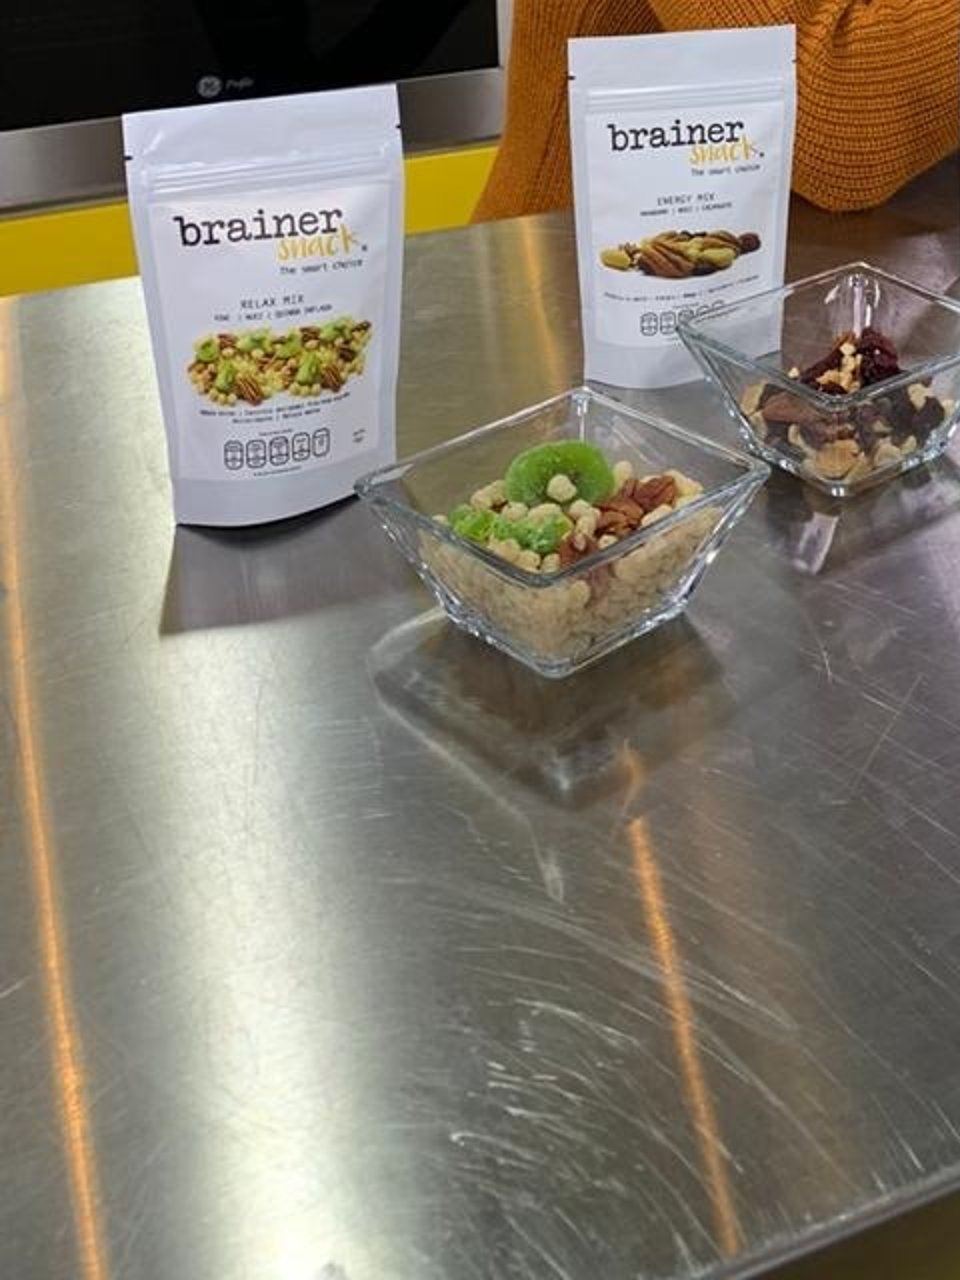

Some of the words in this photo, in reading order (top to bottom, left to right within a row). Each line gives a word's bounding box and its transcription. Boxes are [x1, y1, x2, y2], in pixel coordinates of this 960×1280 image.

[607, 119, 745, 152] brainer
[172, 208, 343, 247] brainer
[277, 222, 360, 261] snack
[240, 297, 276, 310] RELAX
